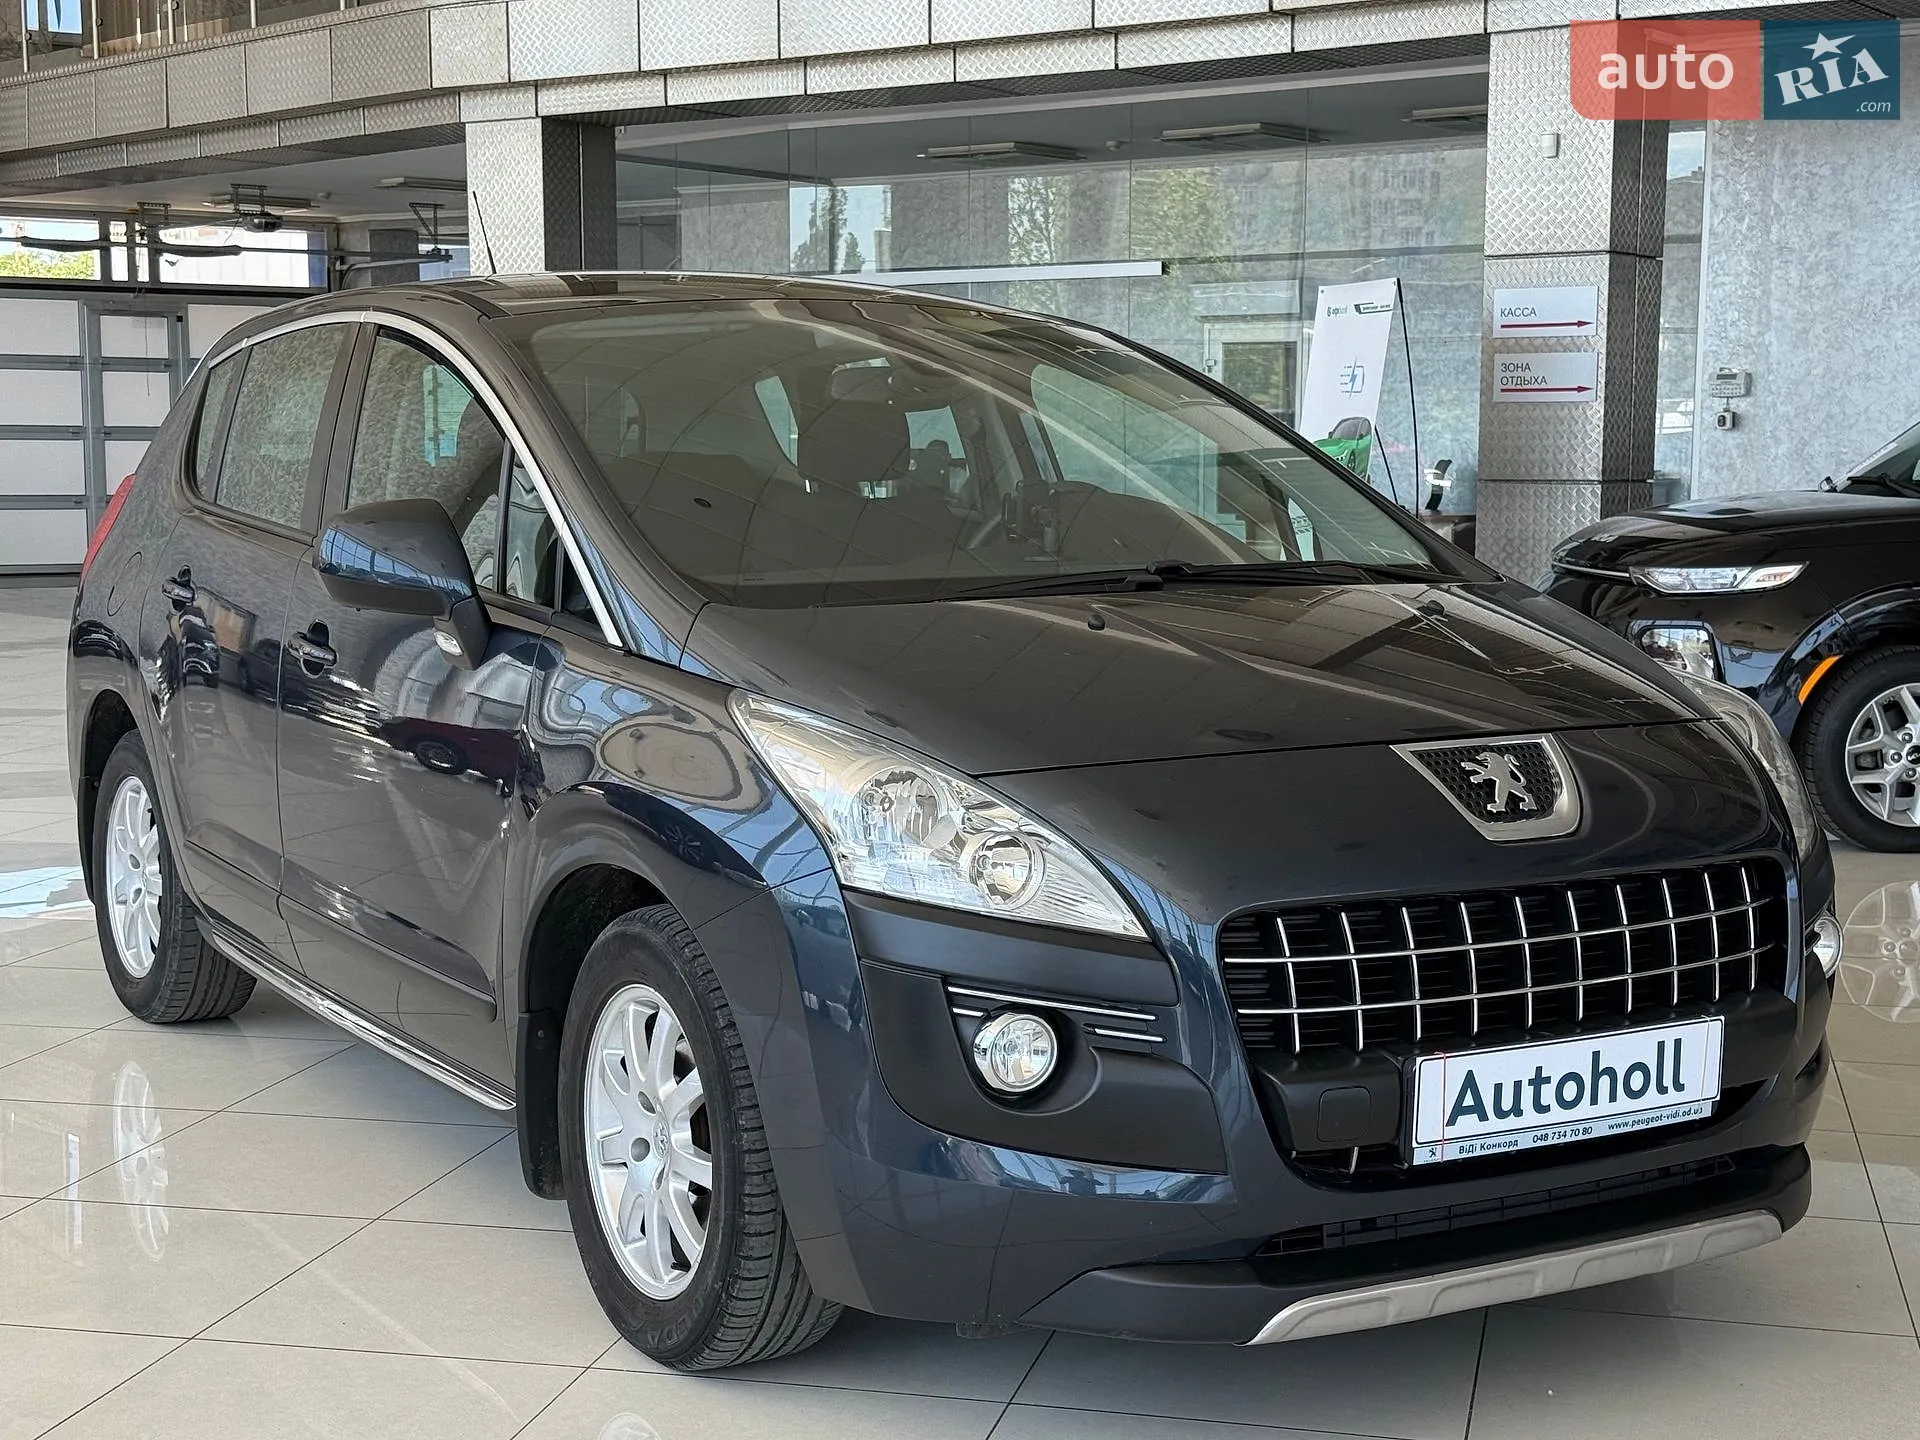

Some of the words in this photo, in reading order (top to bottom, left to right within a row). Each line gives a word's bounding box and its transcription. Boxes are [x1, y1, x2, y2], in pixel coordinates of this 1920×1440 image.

[1500, 307, 1537, 317] КАССА
[1500, 362, 1531, 373] ЗОНА
[1500, 376, 1547, 387] ОТДЫХА
[1445, 1037, 1685, 1127] Autoholl
[1532, 1133, 1549, 1144] 048
[1551, 1130, 1567, 1141] 734
[1569, 1128, 1580, 1138] 70
[1581, 1126, 1593, 1136] 80
[1479, 1139, 1519, 1151] Конкорд
